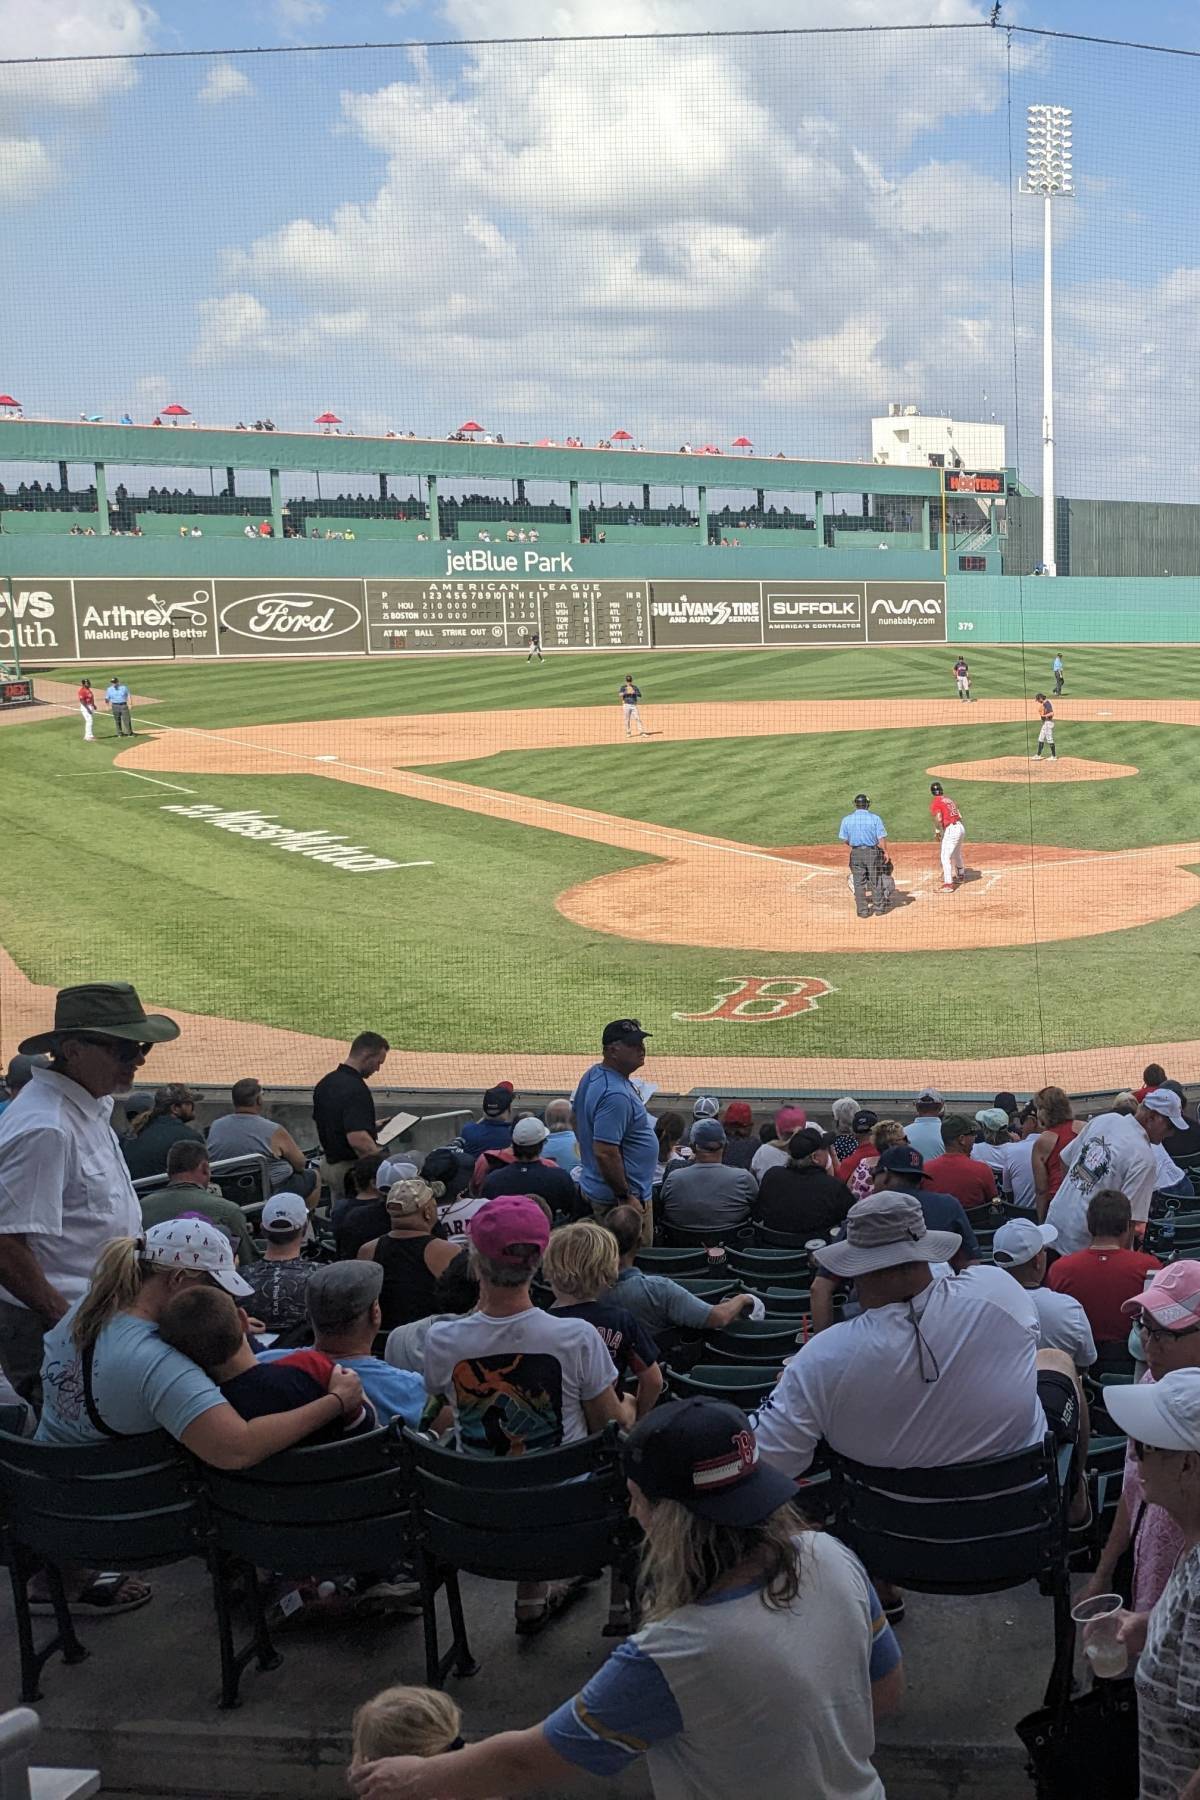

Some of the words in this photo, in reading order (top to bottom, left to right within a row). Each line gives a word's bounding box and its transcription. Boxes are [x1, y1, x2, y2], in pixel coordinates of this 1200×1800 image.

[446, 550, 518, 576] jetBlue
[524, 552, 574, 572] Park
[398, 602, 414, 610] HOU
[422, 602, 428, 610] 2
[431, 602, 434, 610] 1
[437, 602, 442, 610] 0
[447, 602, 452, 610] 0
[455, 602, 460, 610] 0
[462, 602, 467, 610] 0
[472, 602, 477, 610] 0
[650, 602, 712, 616] SULLIVAN
[731, 602, 759, 615] TIRE
[773, 602, 855, 614] SUFFOLK
[870, 599, 942, 614] nuna
[82, 606, 174, 627] Arthrex
[249, 599, 335, 633] Ford
[669, 616, 688, 624] AND
[878, 617, 936, 626] nunababy.com
[958, 622, 973, 630] 379
[0, 622, 58, 648] alth
[84, 629, 128, 641] Making
[131, 629, 170, 640] People
[172, 629, 208, 640] Better
[672, 976, 842, 1022] B
